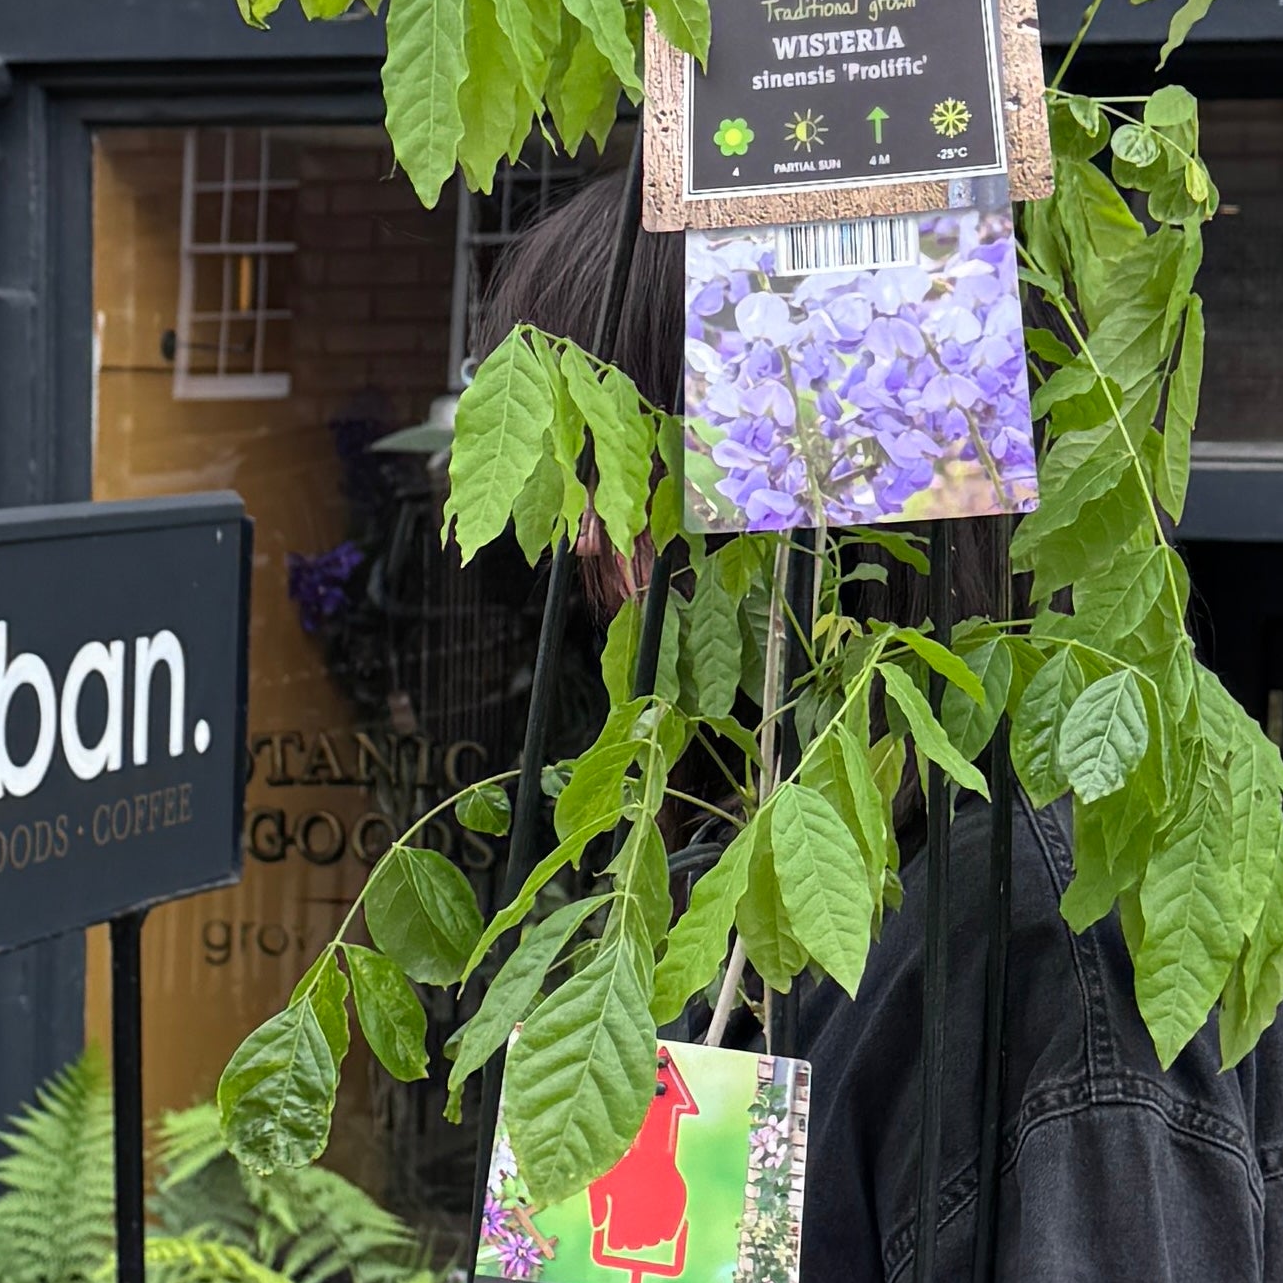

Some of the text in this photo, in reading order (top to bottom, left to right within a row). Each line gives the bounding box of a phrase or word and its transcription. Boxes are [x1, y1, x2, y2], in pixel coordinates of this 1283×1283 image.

[772, 25, 905, 61] WISTERIA
[752, 65, 836, 90] sinensis
[773, 159, 842, 174] PARTIAL SUN
[247, 731, 487, 789] TANIC
[92, 781, 195, 850] COFFEE
[202, 919, 310, 966] gro
